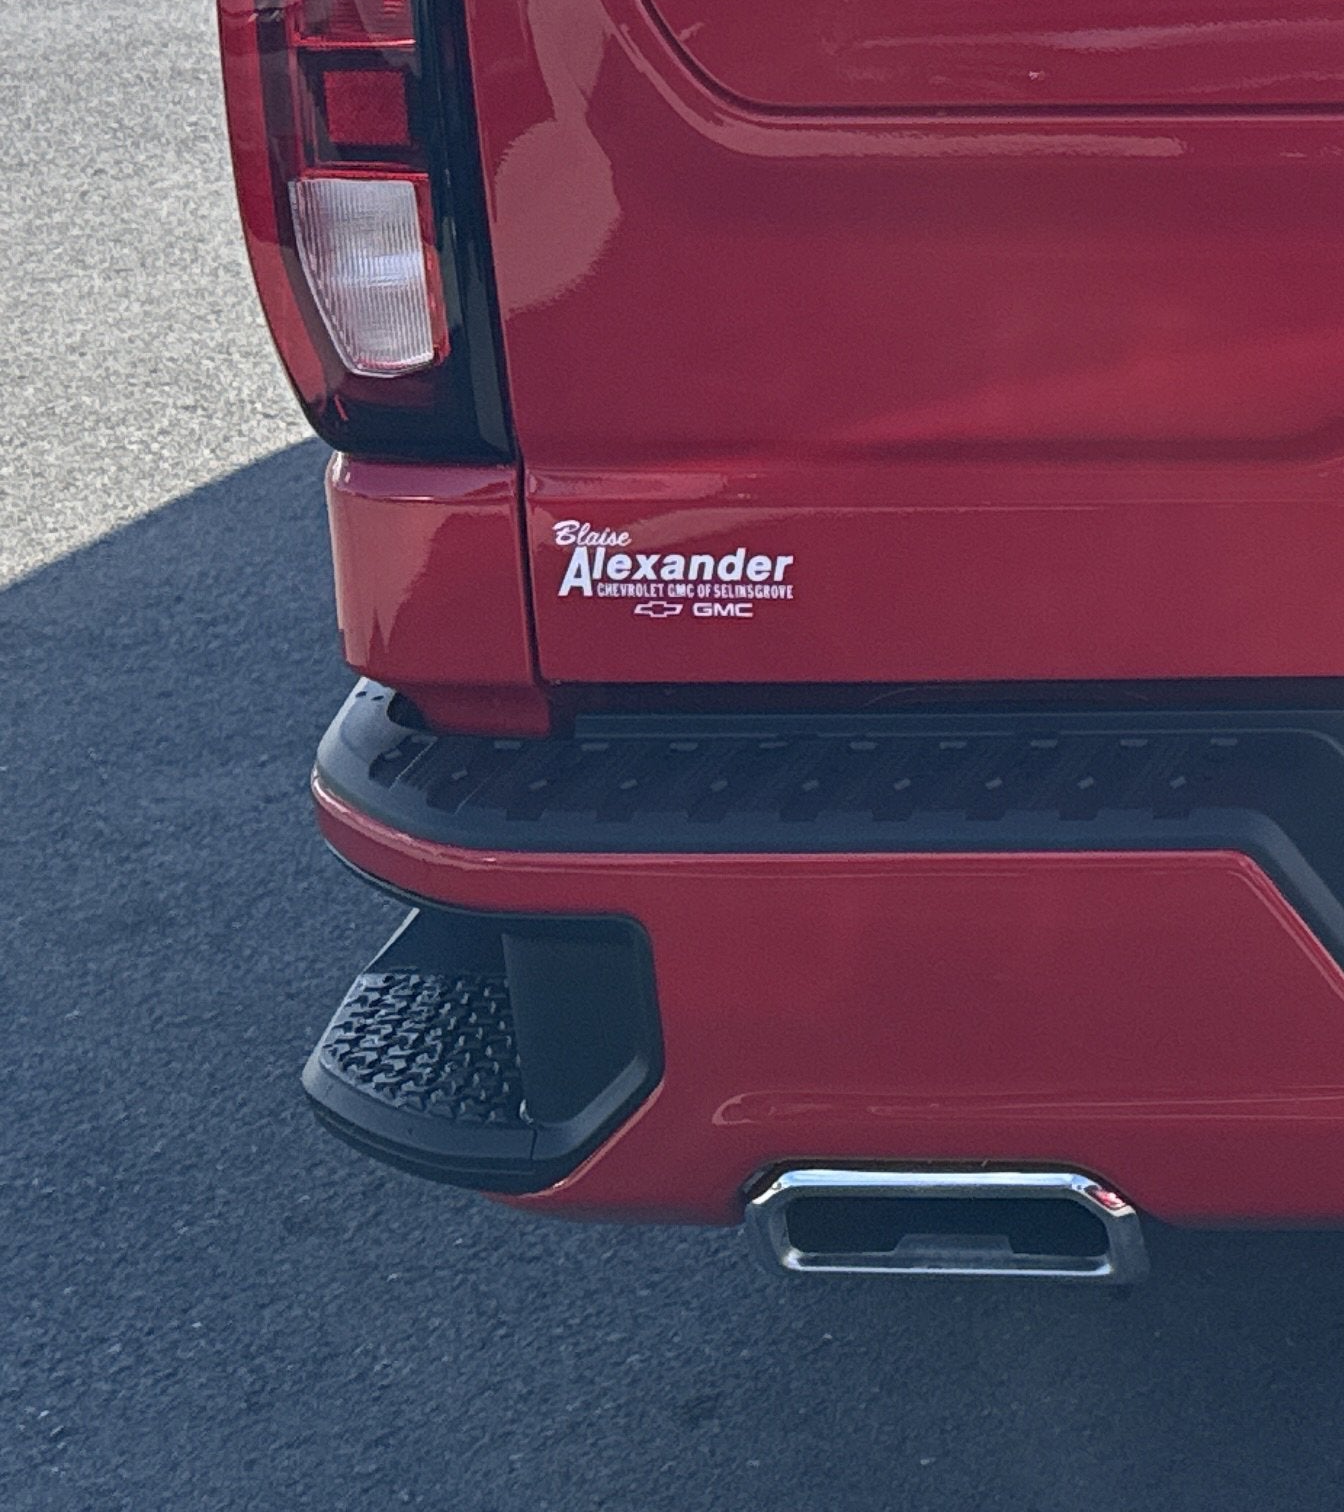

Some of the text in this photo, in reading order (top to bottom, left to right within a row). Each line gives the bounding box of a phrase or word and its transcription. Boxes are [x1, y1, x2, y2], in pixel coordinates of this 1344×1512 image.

[552, 519, 632, 547] Blaise
[558, 546, 794, 597] Alexander
[597, 582, 794, 600] CHEVROLET GMC OF SELINSGROVE
[692, 602, 753, 618] GMC
